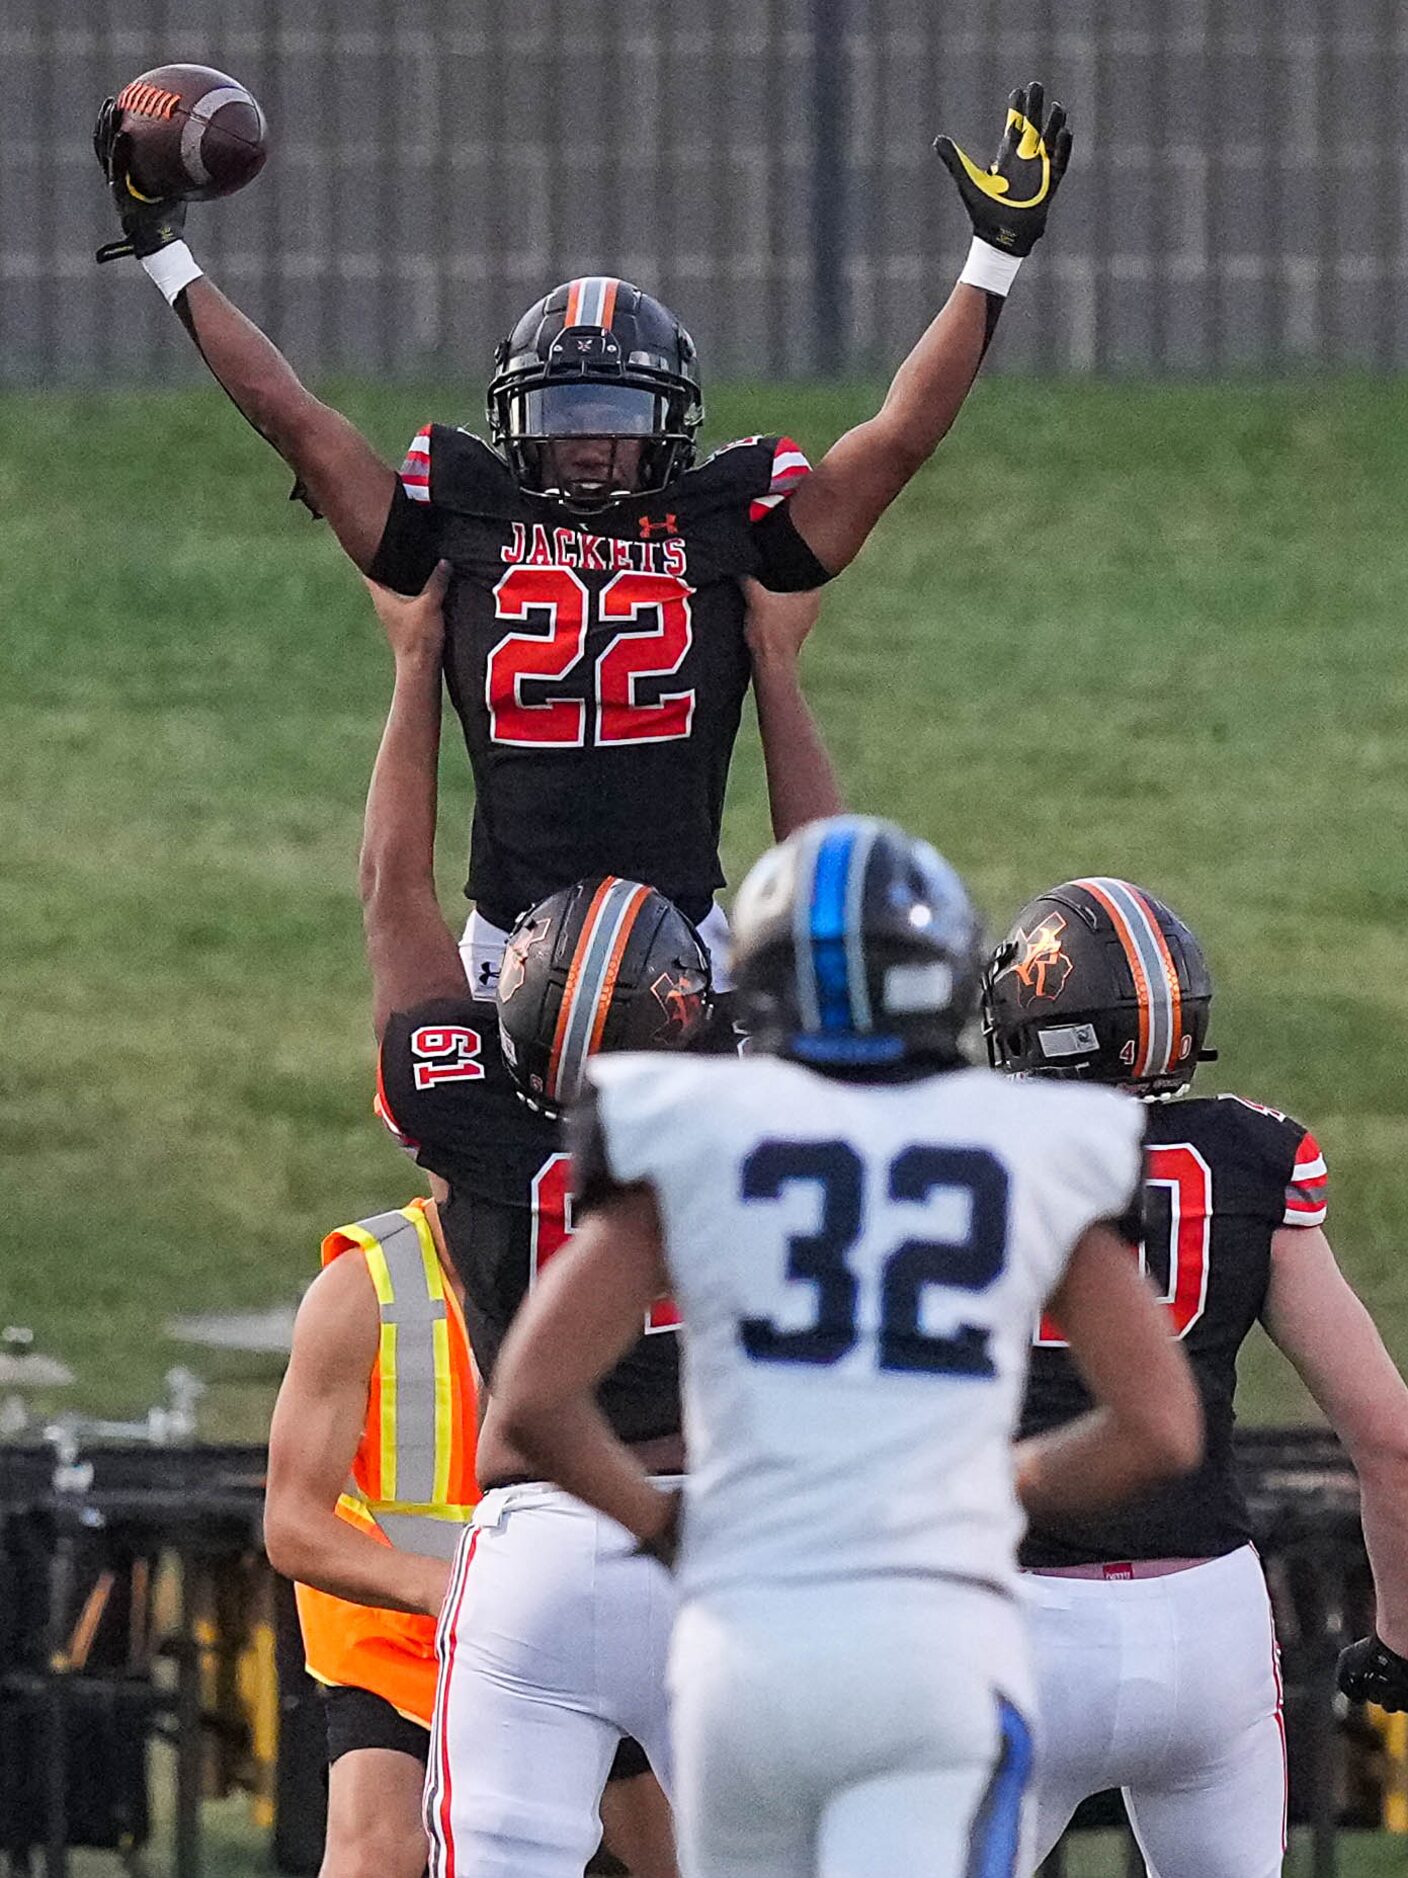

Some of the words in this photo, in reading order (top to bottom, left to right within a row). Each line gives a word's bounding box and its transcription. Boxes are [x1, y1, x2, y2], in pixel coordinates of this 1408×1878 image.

[501, 521, 686, 577] JACKETS
[486, 563, 698, 748] 22
[411, 1025, 485, 1091] 61
[740, 1137, 1012, 1379] 32
